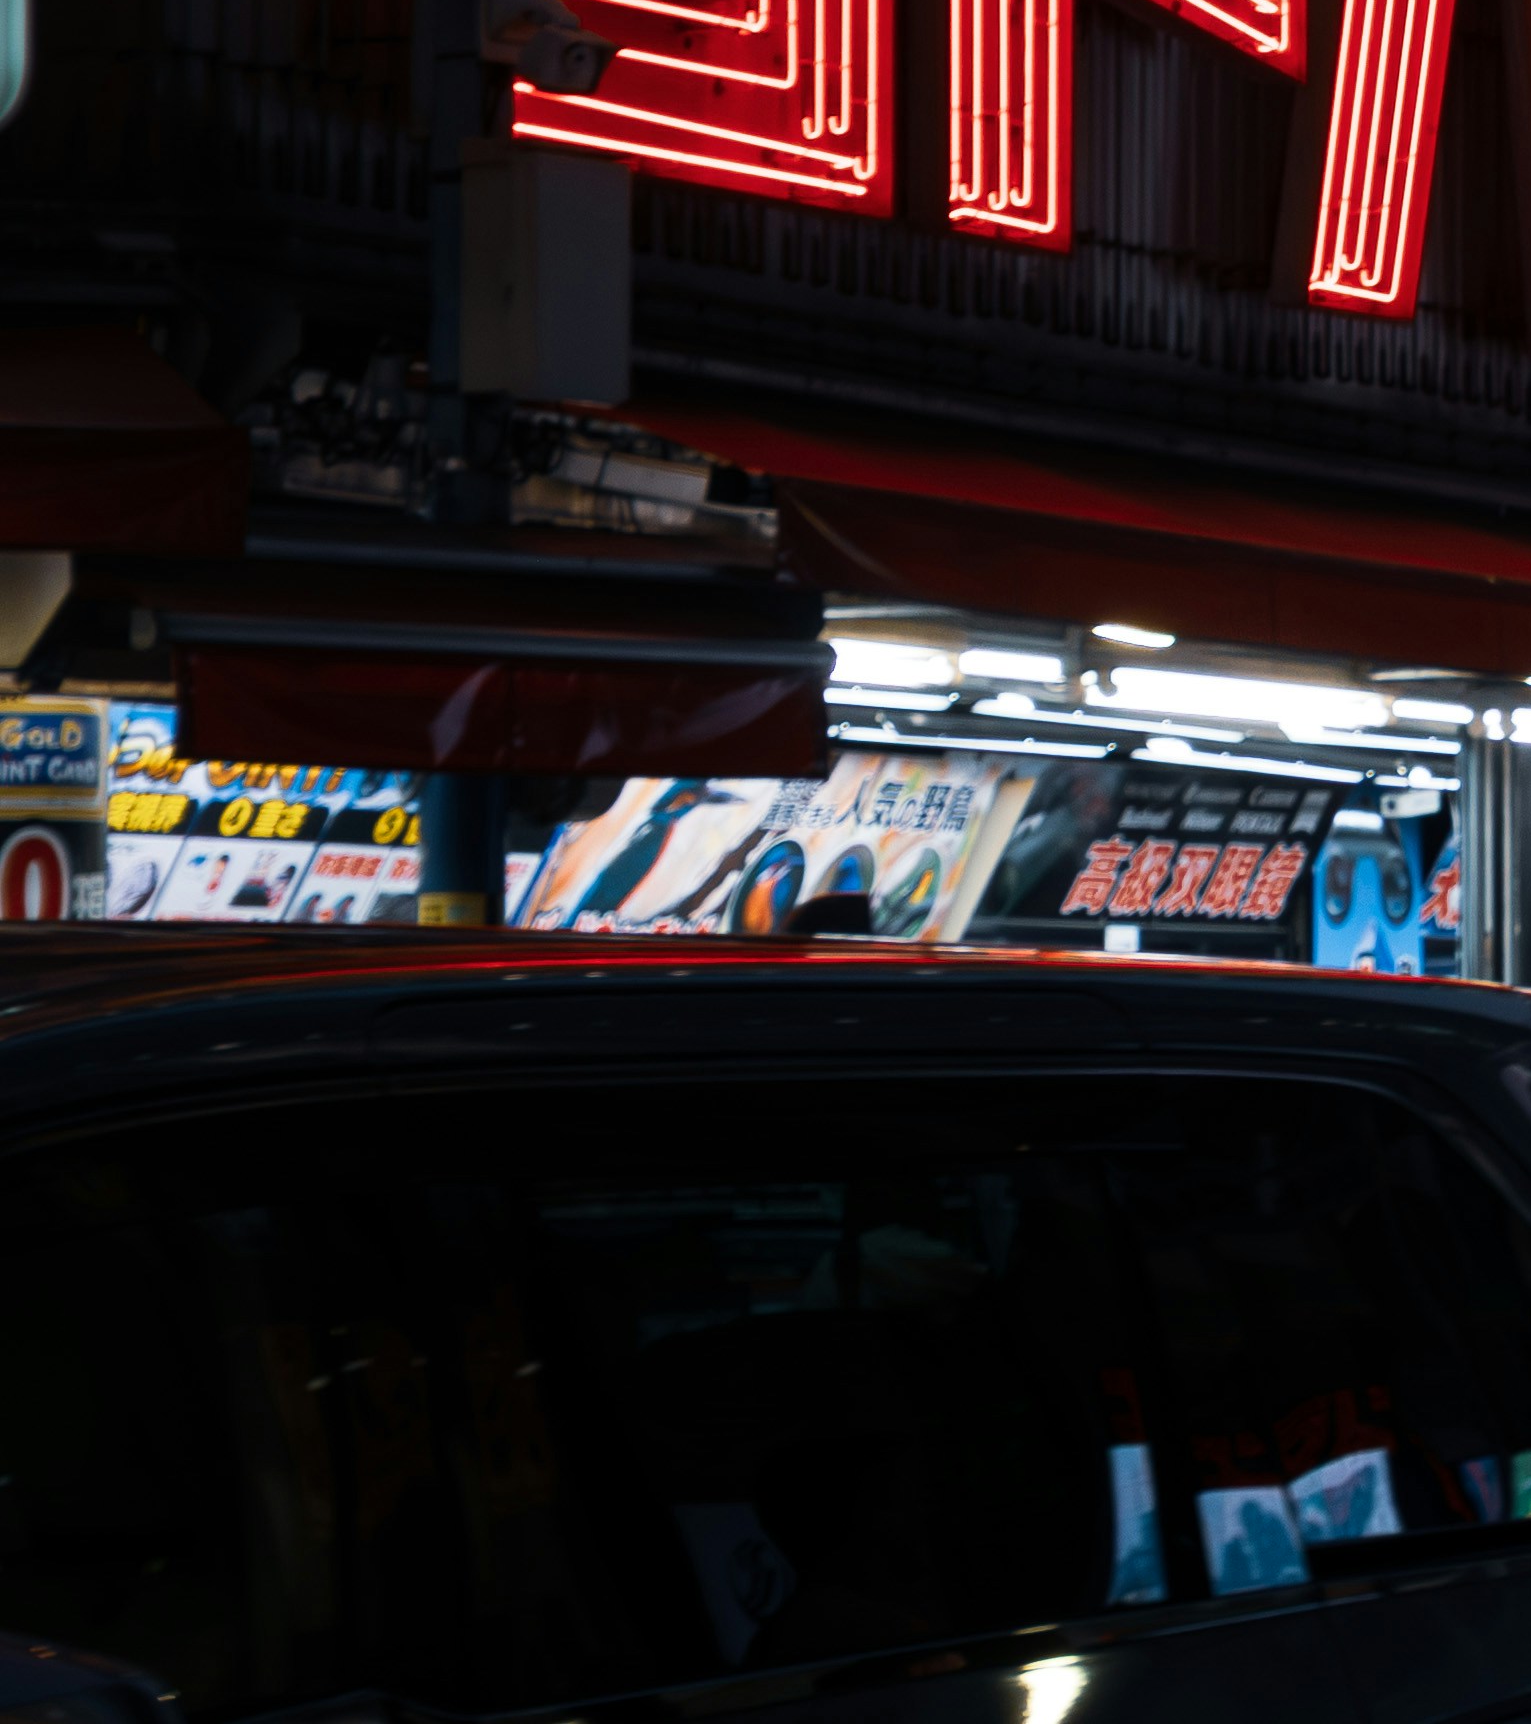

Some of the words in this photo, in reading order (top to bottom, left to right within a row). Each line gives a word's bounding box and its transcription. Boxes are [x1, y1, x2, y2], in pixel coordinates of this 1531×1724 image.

[1059, 833, 1309, 920] 高級双眼鏡
